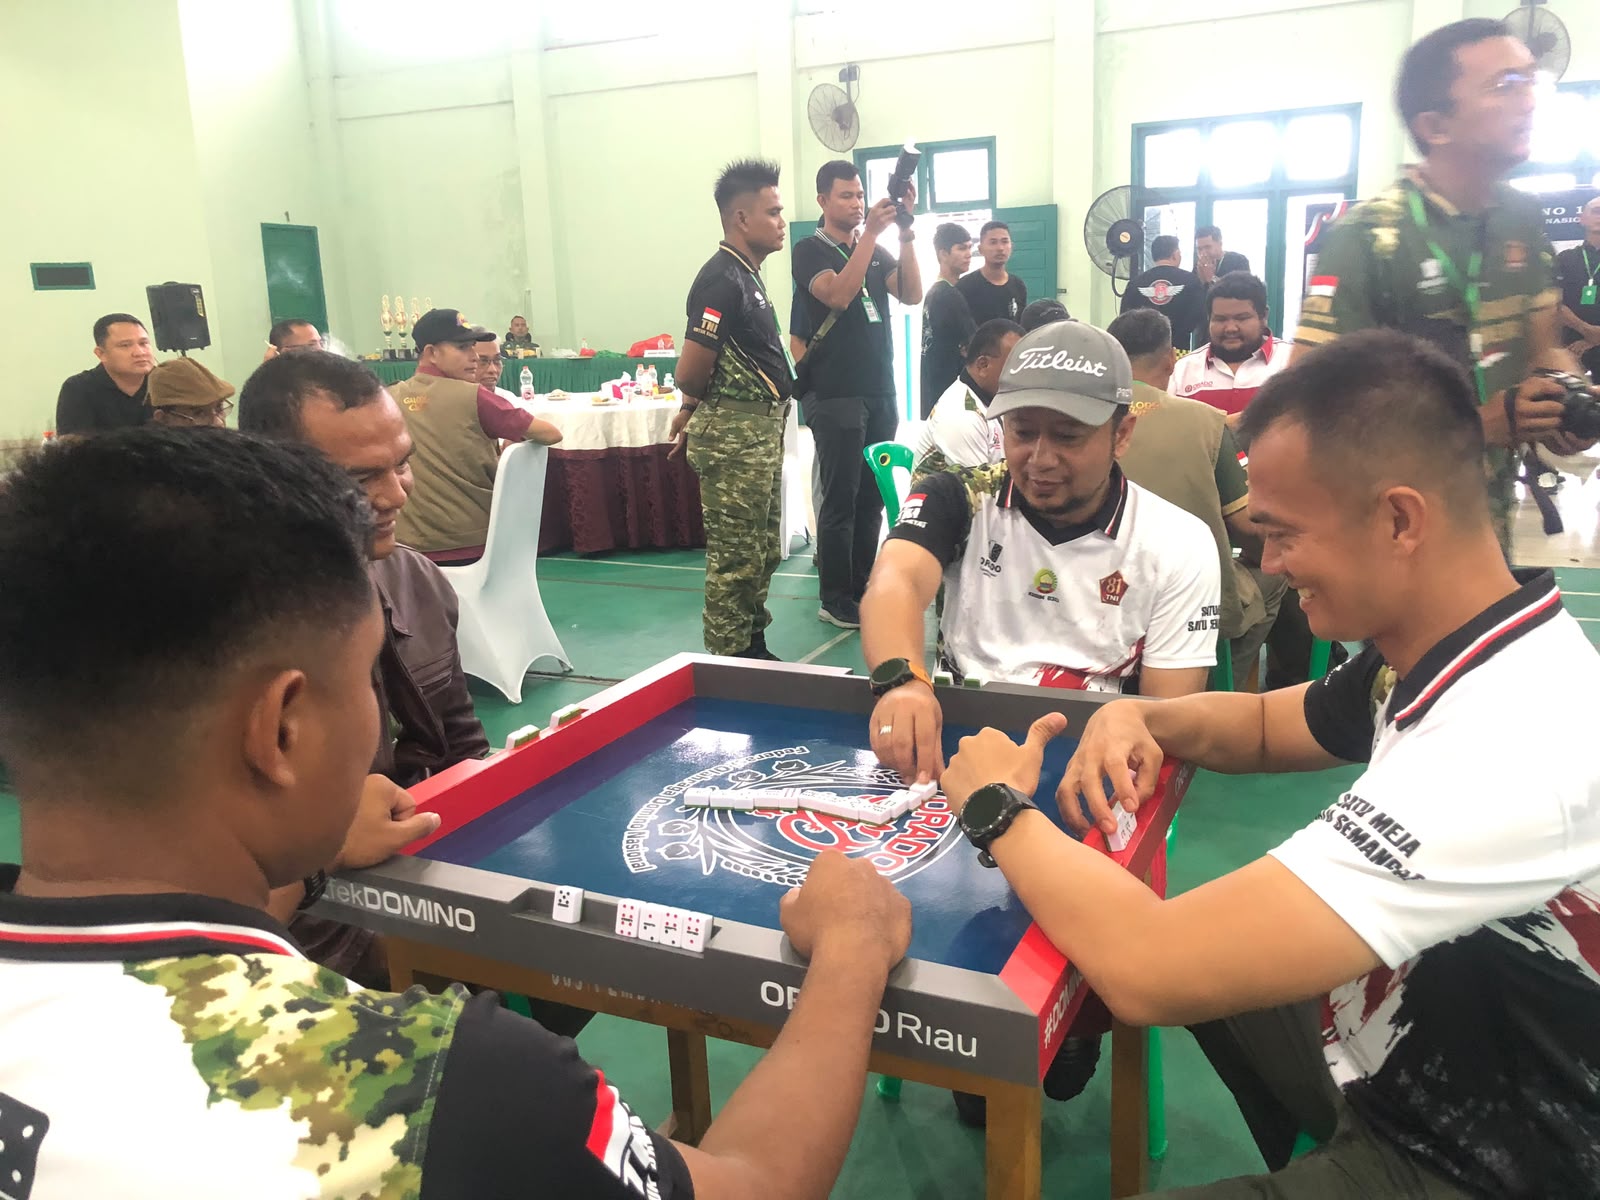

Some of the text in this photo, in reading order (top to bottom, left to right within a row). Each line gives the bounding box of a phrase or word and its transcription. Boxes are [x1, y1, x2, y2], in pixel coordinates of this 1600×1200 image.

[1010, 345, 1108, 377] Titleist
[1106, 578, 1122, 595] 81
[1106, 594, 1120, 602] TNI
[624, 830, 655, 872] Nasional
[866, 796, 953, 873] ORADO
[1368, 811, 1421, 858] MEJA
[320, 877, 476, 932] fekDOMINO
